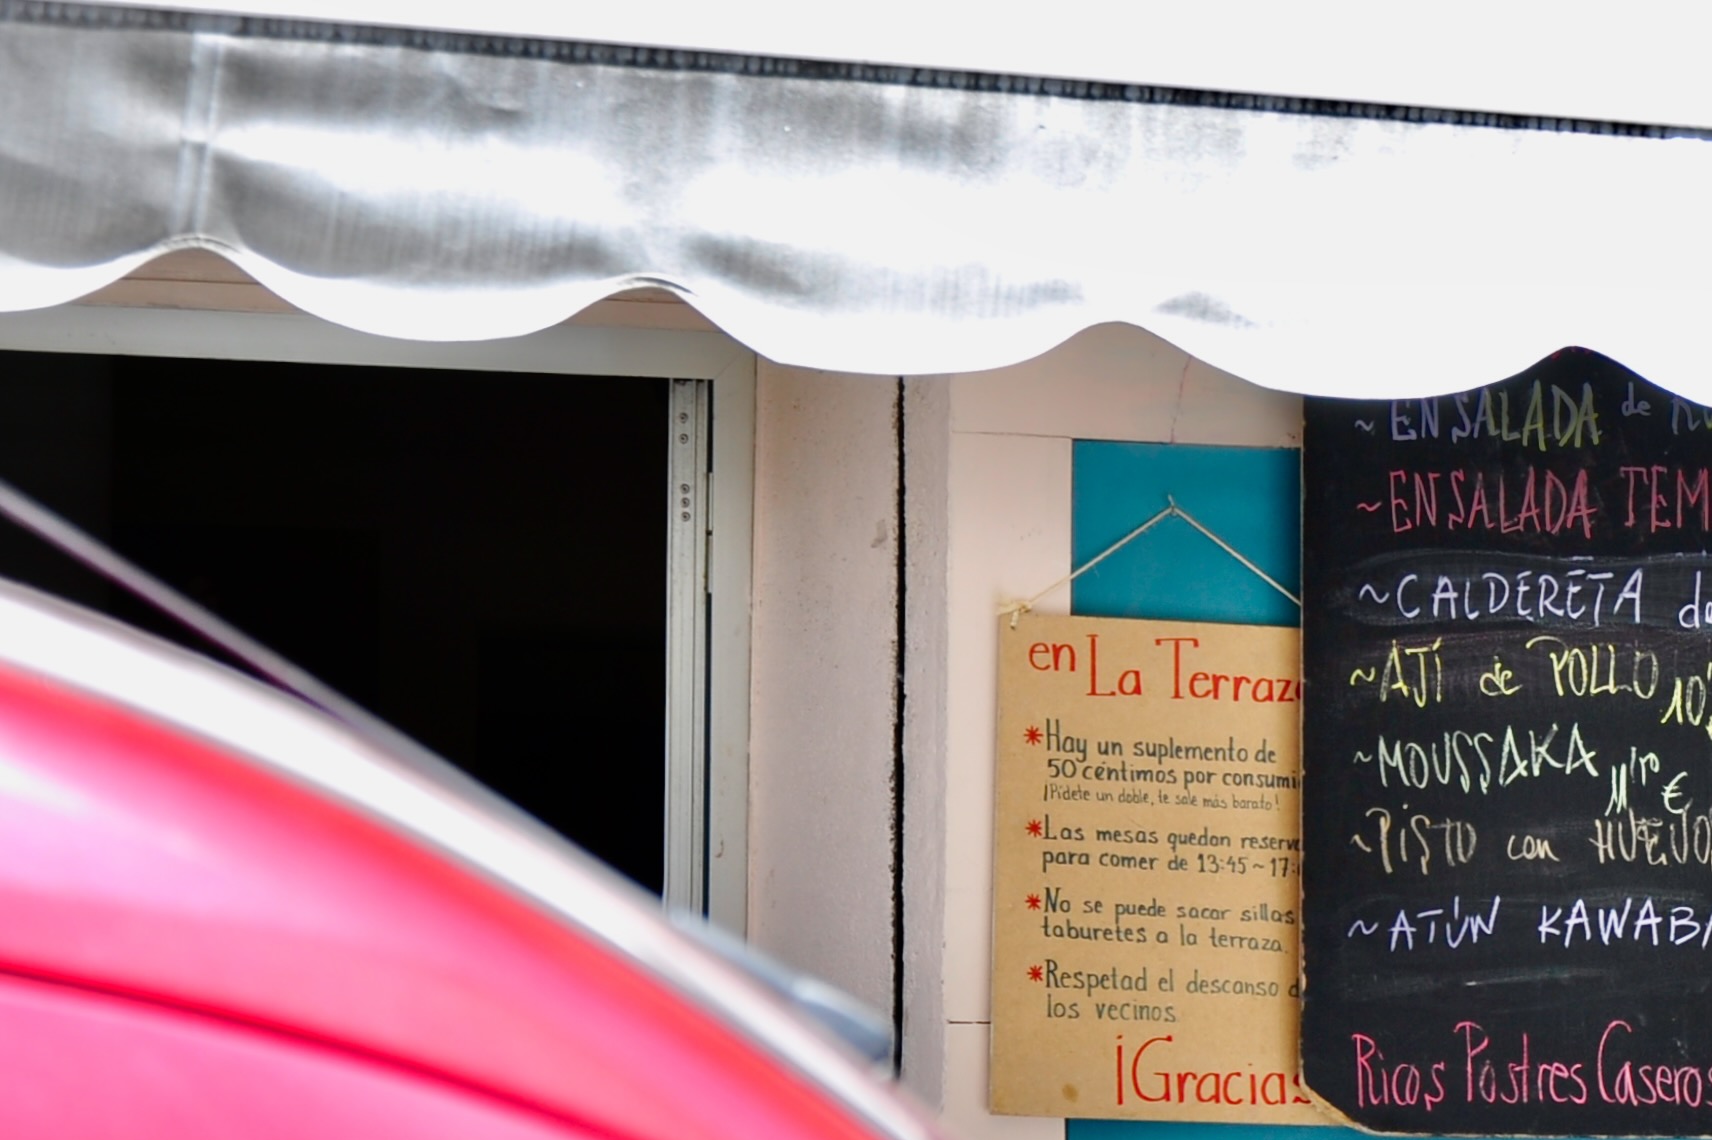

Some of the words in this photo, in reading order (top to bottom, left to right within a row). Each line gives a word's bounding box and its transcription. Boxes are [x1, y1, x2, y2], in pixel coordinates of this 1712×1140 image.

[1621, 381, 1652, 416] de
[1390, 466, 1599, 539] ENSALADA
[1396, 567, 1643, 627] CALDERETA
[1028, 641, 1076, 672] en
[1086, 633, 1143, 697] La
[1479, 654, 1524, 696] de
[1525, 635, 1660, 700] POLLO
[1045, 718, 1088, 763] Hay
[1097, 739, 1124, 757] un
[1132, 736, 1249, 765] suplemento
[1254, 738, 1277, 763] de
[1377, 722, 1600, 795] MOUSSAKA
[1047, 758, 1077, 779] 50
[1184, 770, 1216, 790] por
[1222, 769, 1300, 790] consumi
[1096, 791, 1114, 802] un
[1158, 789, 1170, 804] te
[1175, 789, 1198, 807] sale
[1042, 813, 1086, 842] Las
[1096, 827, 1159, 845] mesas
[1167, 826, 1232, 853] quedan
[1507, 834, 1560, 863] con
[1042, 850, 1090, 873] para
[1099, 852, 1160, 871] comer
[1167, 853, 1189, 872] de
[1043, 886, 1072, 914] No
[1083, 897, 1104, 914] se
[1114, 897, 1167, 925] puede
[1176, 905, 1232, 921] sacar
[1240, 902, 1296, 925] sillas
[1041, 915, 1148, 944] taburetes
[1155, 931, 1170, 944] a
[1179, 923, 1198, 946] la
[1045, 959, 1148, 997] Respetad
[1158, 968, 1175, 993] el
[1185, 969, 1280, 997] descanso
[1046, 993, 1080, 1019] los
[1351, 1032, 1446, 1112] Ricos
[1453, 1020, 1589, 1105] Postres
